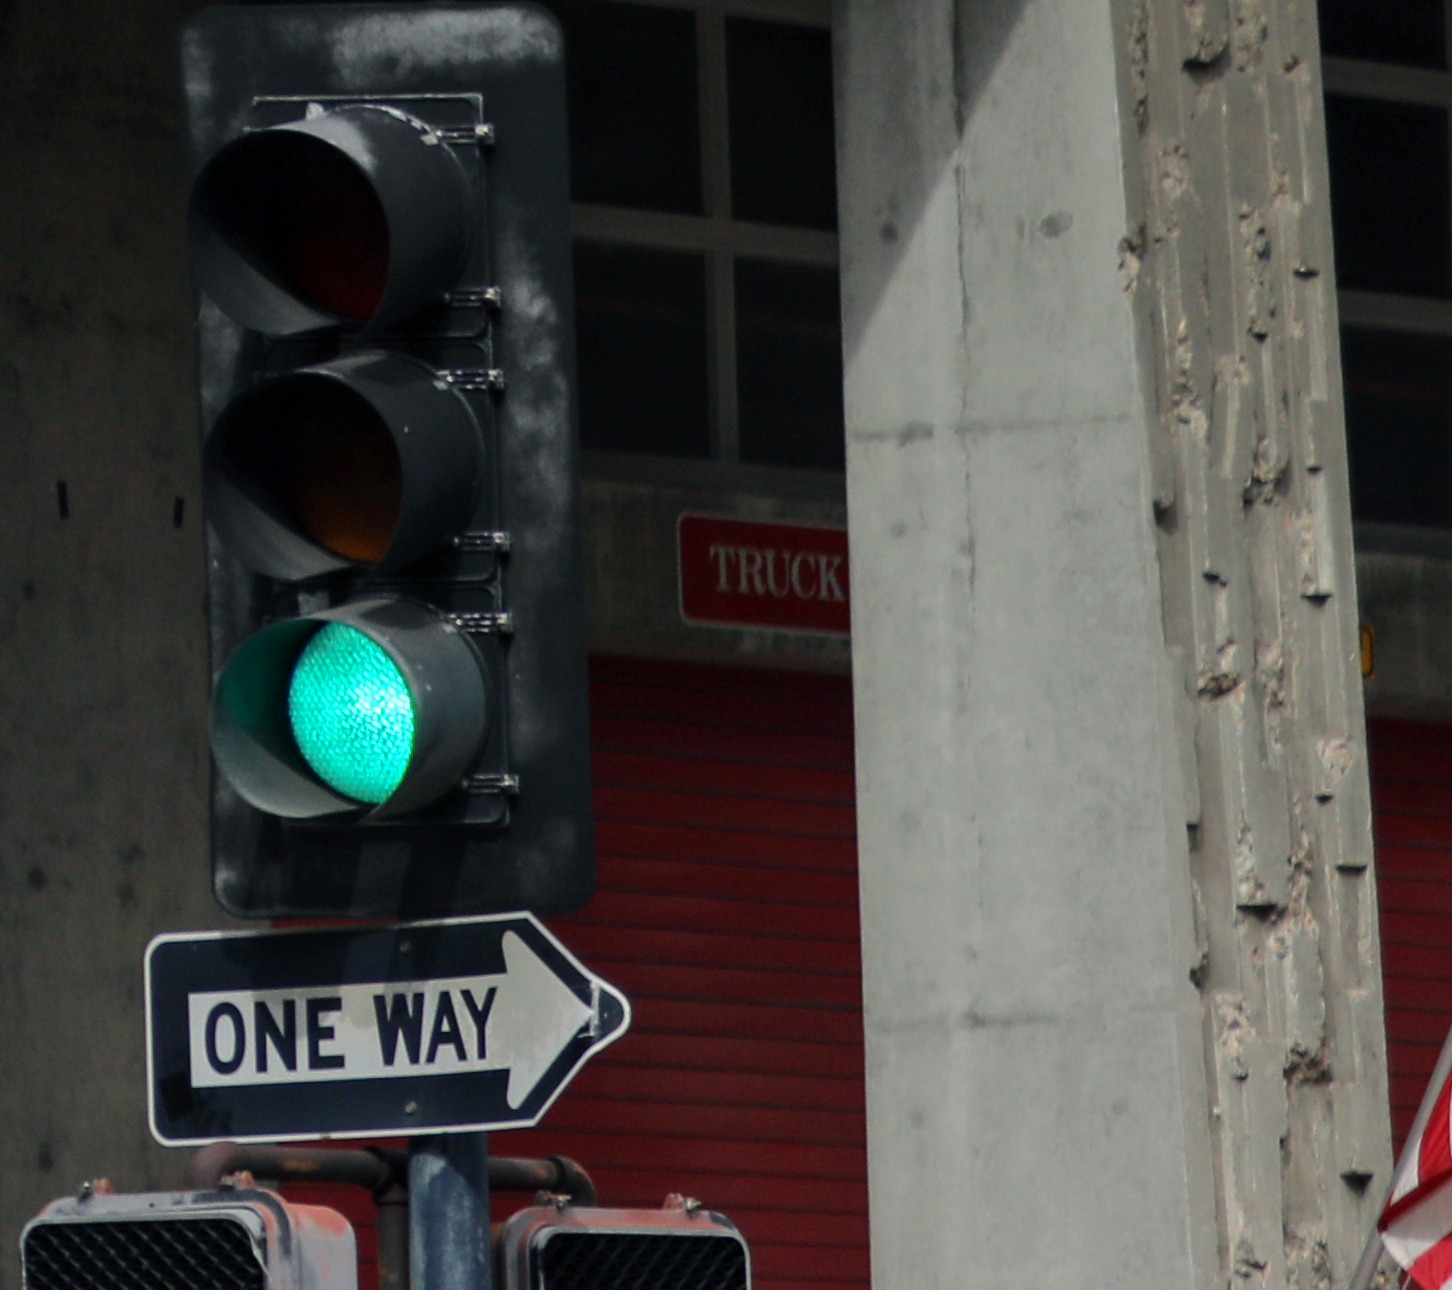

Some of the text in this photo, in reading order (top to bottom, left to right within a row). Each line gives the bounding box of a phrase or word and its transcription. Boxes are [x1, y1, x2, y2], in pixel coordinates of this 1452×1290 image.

[709, 544, 845, 602] TRUCK
[205, 986, 498, 1075] ONE WAY
